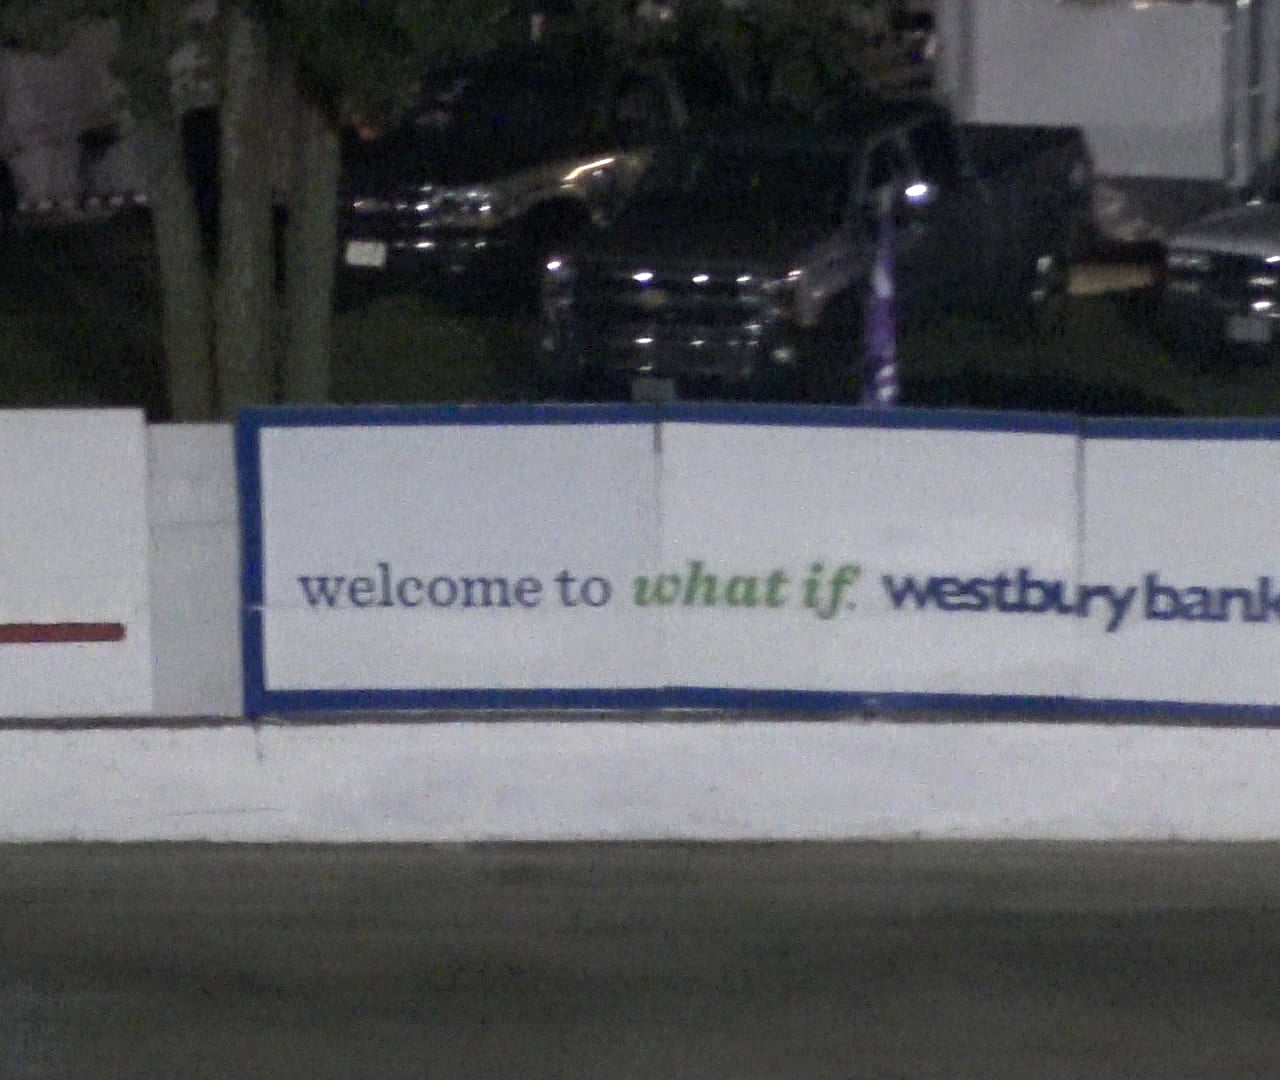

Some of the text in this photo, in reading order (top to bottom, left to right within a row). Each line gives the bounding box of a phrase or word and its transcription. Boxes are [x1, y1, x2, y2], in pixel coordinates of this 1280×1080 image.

[297, 560, 861, 622] welcome to what if.
